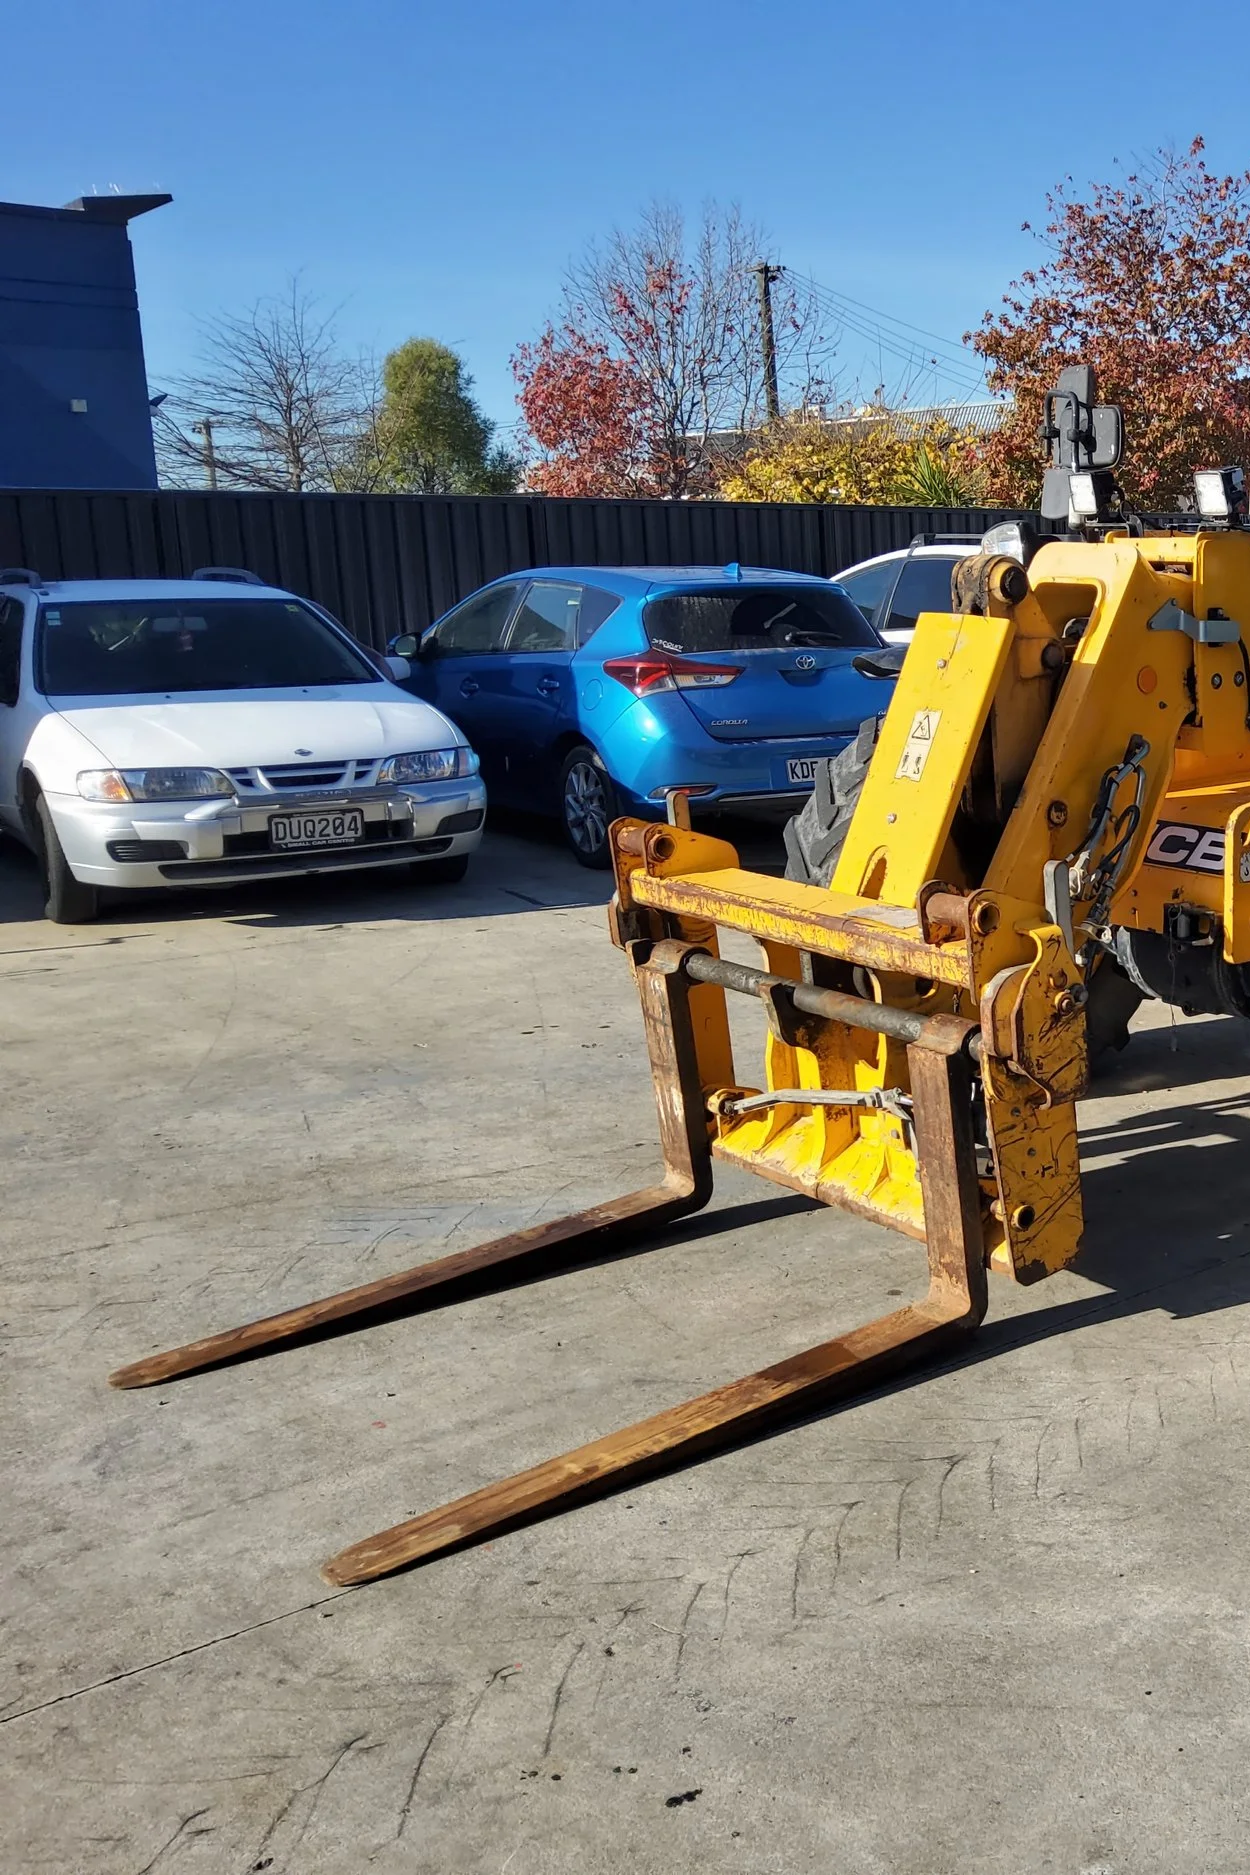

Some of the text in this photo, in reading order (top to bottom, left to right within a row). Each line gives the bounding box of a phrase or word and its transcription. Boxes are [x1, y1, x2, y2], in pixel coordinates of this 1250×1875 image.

[789, 761, 818, 780] KDF
[274, 815, 360, 842] DUQ204
[1147, 825, 1225, 870] CB
